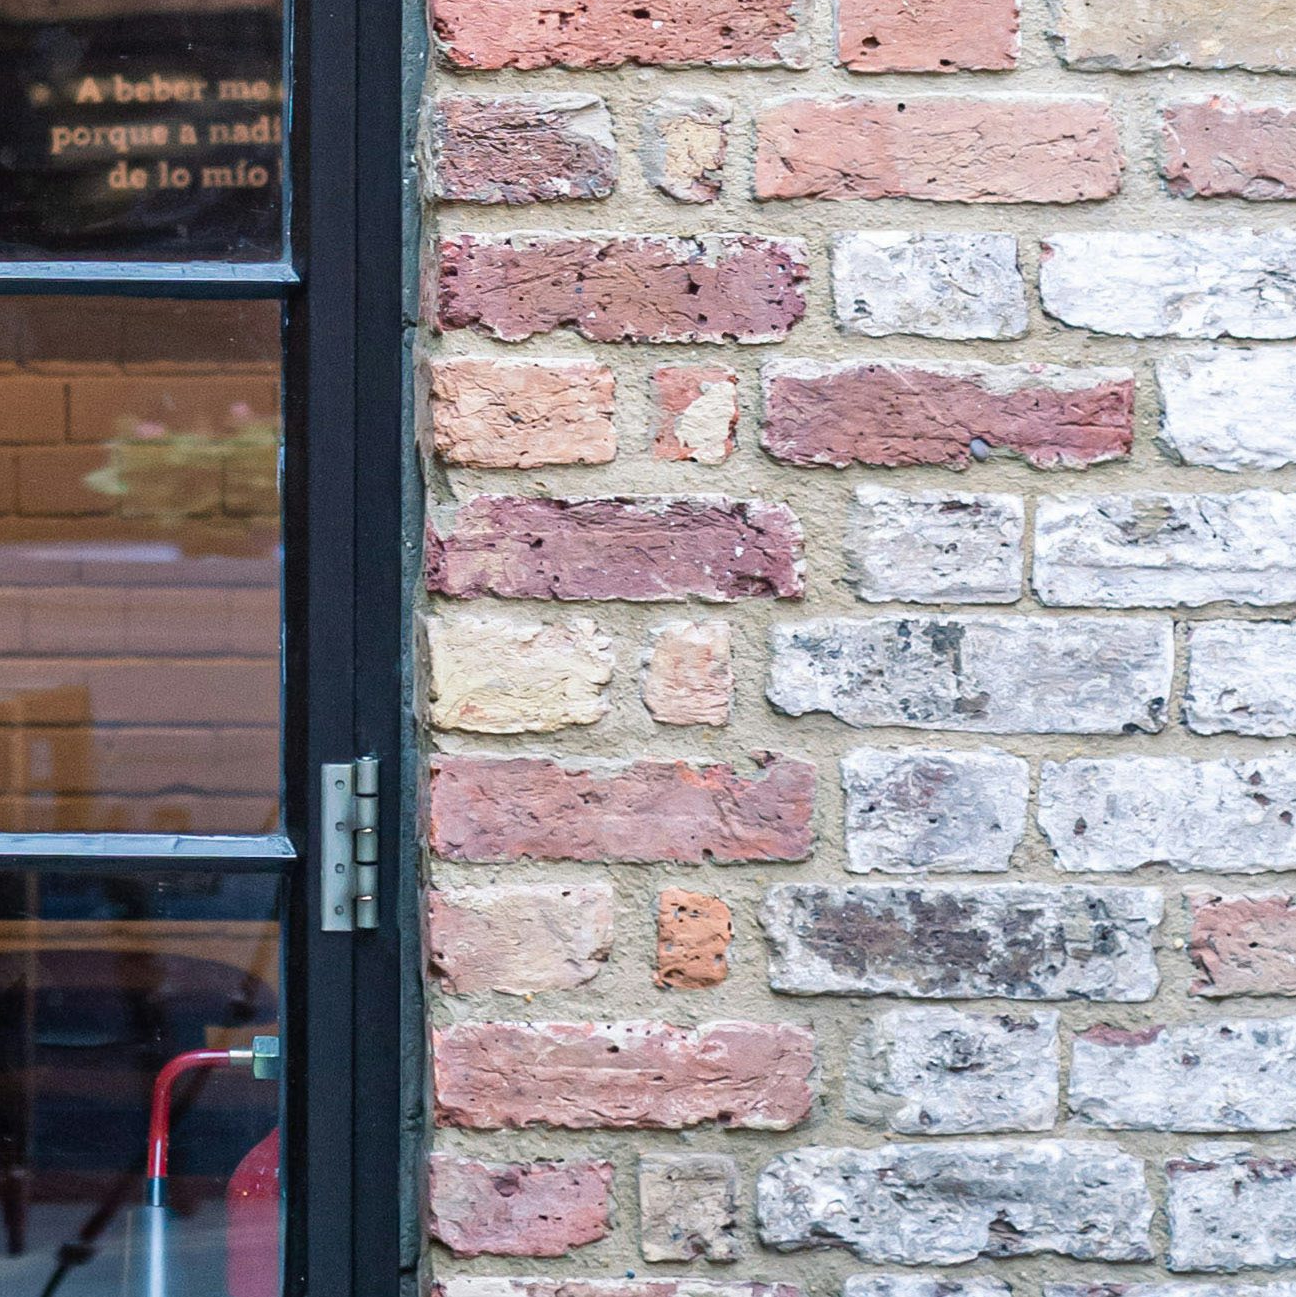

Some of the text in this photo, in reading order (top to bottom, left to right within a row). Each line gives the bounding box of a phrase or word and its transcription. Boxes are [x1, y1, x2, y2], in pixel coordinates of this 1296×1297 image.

[76, 77, 104, 103] A
[116, 73, 206, 103] beber
[219, 78, 270, 102] me
[50, 120, 170, 155] porque
[108, 159, 148, 190] de
[159, 160, 192, 190] lo
